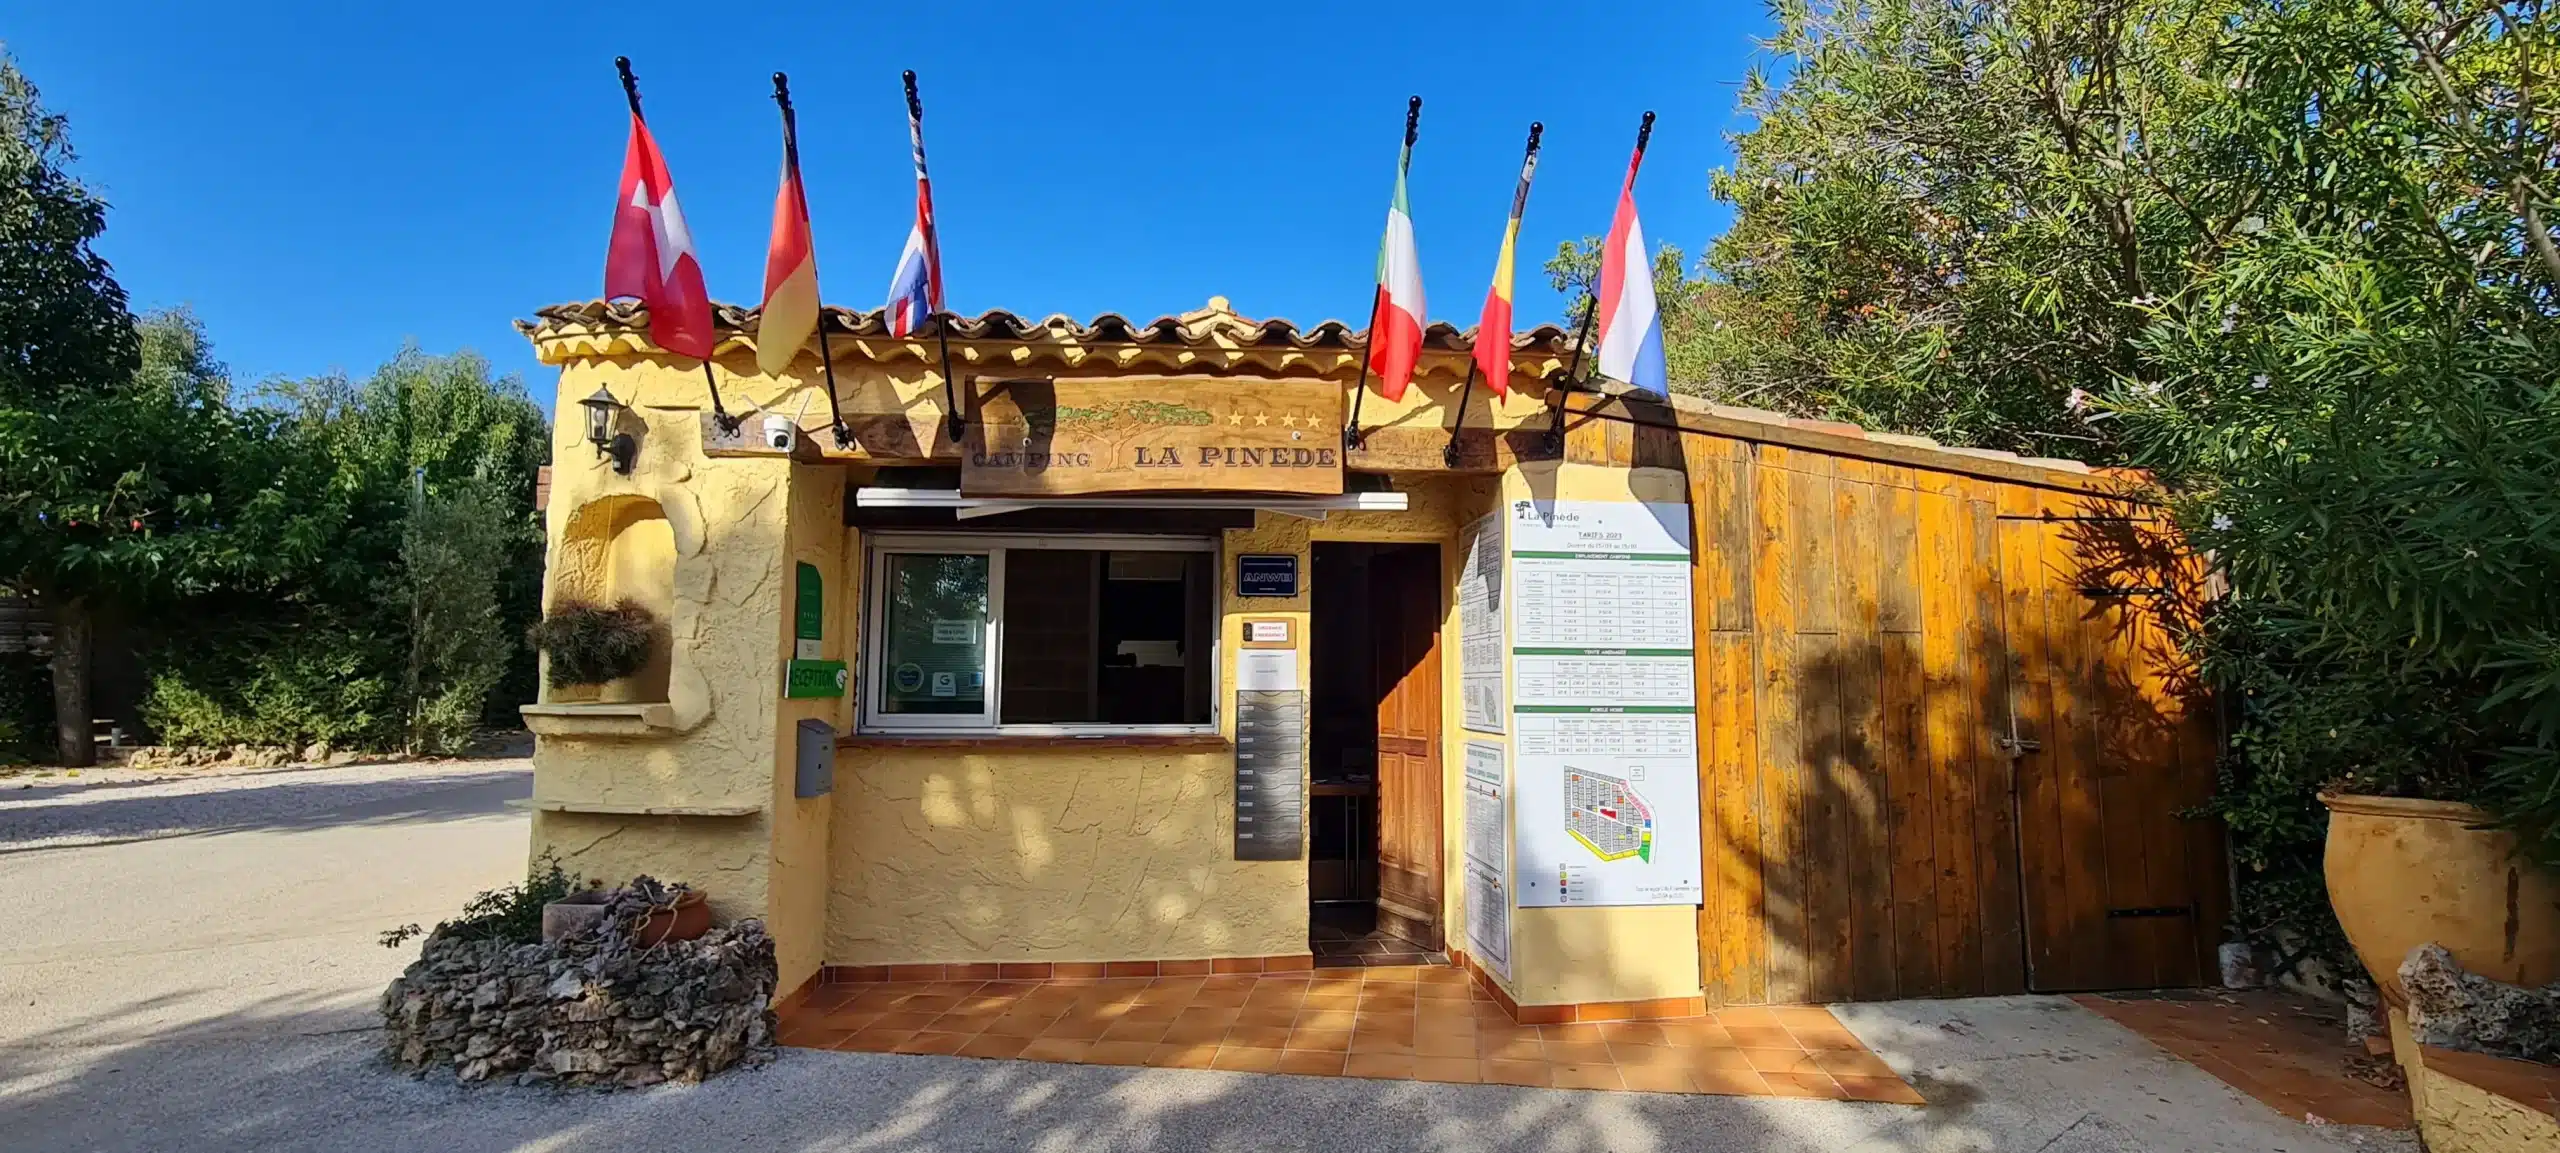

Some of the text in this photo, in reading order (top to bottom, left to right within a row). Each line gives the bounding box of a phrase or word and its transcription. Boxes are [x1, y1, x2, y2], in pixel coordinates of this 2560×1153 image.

[972, 446, 1338, 469] CAMPING LA PINEDE
[1528, 511, 1540, 520] La
[1578, 531, 1603, 539] TARIFS
[1243, 572, 1292, 582] ANWB
